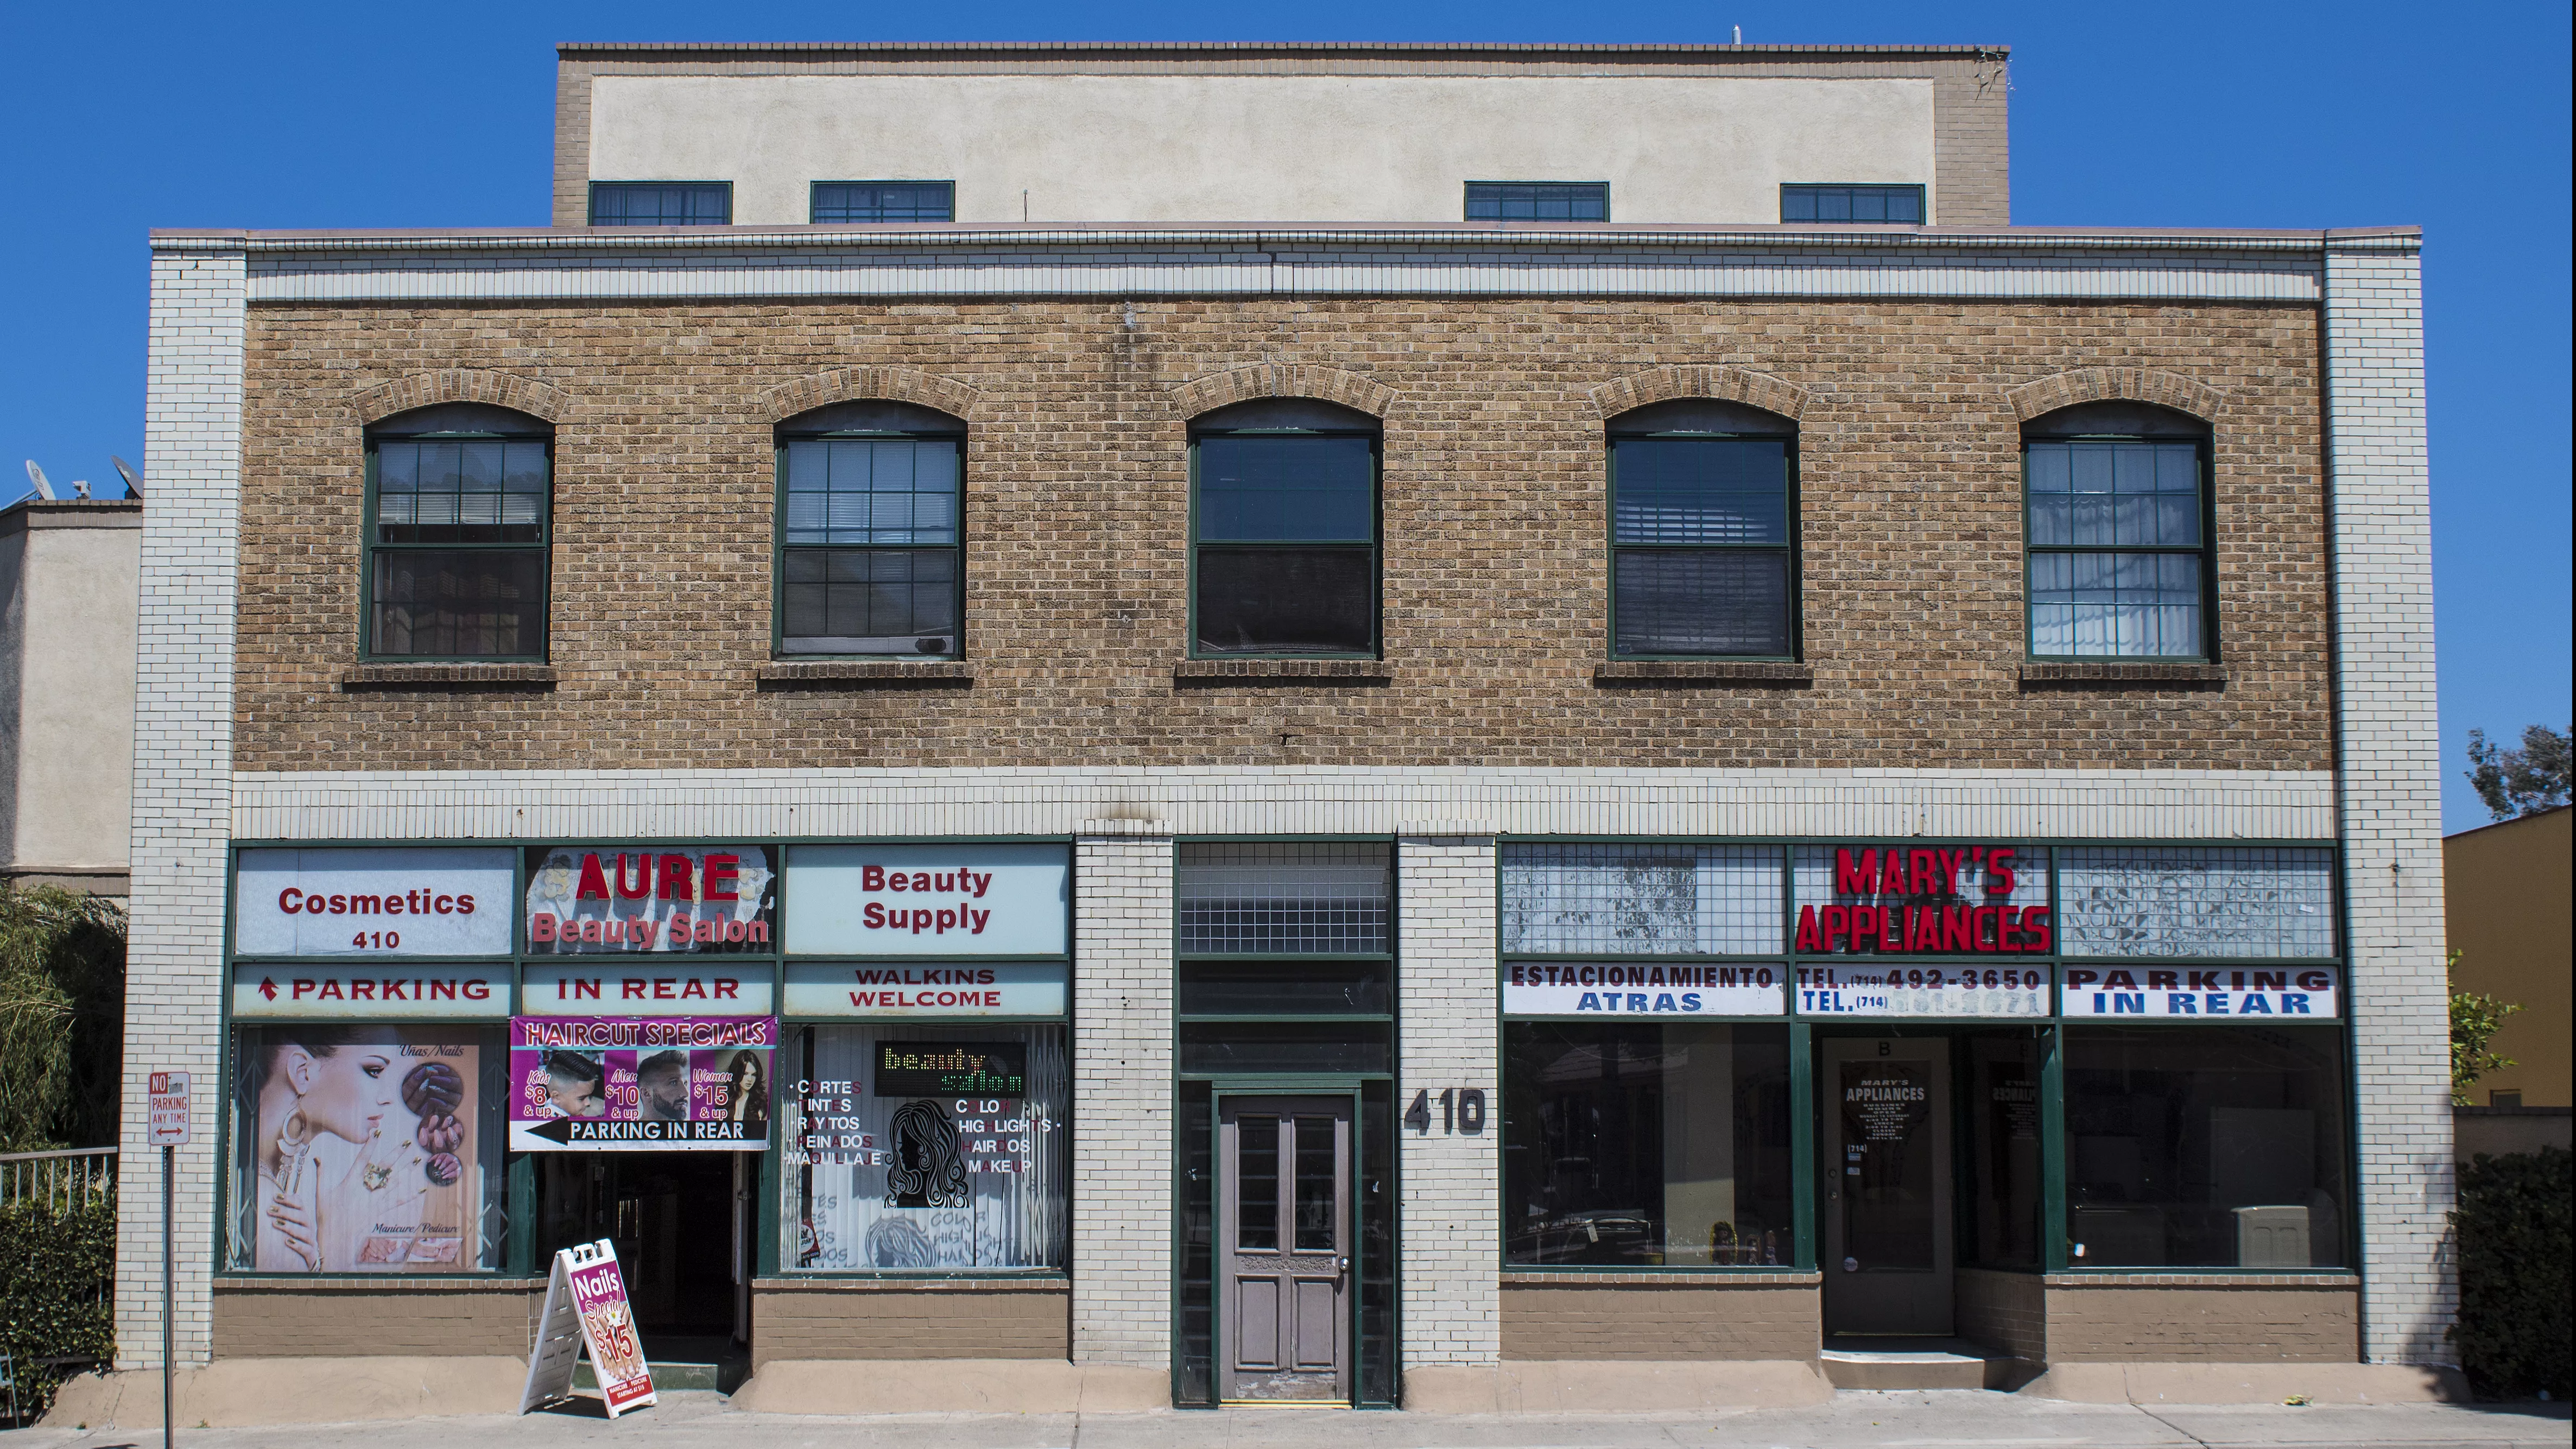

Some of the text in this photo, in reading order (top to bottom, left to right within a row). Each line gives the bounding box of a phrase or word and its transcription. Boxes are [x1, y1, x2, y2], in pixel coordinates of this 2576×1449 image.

[575, 853, 740, 901] AURE
[1837, 846, 2015, 895] MARY'S
[862, 865, 992, 898] Beauty
[279, 888, 476, 914] Cosmetics
[863, 902, 991, 934] Supply
[533, 913, 769, 949] Beauty Salon
[1796, 904, 2050, 951] APPLIANCES
[352, 932, 400, 948] 410
[855, 970, 995, 985] WALKINS
[1511, 966, 1773, 989] ESTACIONAMIENTO
[1797, 968, 2040, 990] TEL. (714) 492-3650
[2068, 970, 2330, 992] PARKING
[293, 979, 490, 1000] PARKING
[558, 978, 738, 999] IN REAR
[849, 991, 1001, 1007] WELCOME
[1576, 992, 1701, 1012] ATRAS
[1803, 991, 1853, 1012] TEL.
[1856, 996, 1888, 1009] (714)
[2093, 992, 2311, 1014] IN REAR
[526, 1022, 767, 1047] HAIRCUT SPECIALS
[1879, 1042, 1891, 1056] B
[885, 1048, 985, 1076] beauty
[152, 1075, 166, 1092] NO
[527, 1070, 552, 1085] Kids
[611, 1069, 638, 1083] Men
[693, 1069, 733, 1082] Women
[941, 1070, 1021, 1091] salon
[525, 1086, 547, 1105] $8
[606, 1086, 640, 1105] $10
[694, 1086, 729, 1105] $15
[798, 1079, 862, 1094] CORTES
[1846, 1087, 1925, 1101] APPLIANCES
[153, 1097, 187, 1111] PARKING
[524, 1106, 552, 1117] & up
[799, 1098, 852, 1112] TINTES
[955, 1099, 1010, 1113] COLOR
[1404, 1087, 1485, 1129] 410
[153, 1113, 186, 1124] ANY TIME
[612, 1108, 640, 1120] & up
[700, 1108, 728, 1120] & up
[571, 1122, 744, 1140] PARKING IN REAR
[798, 1117, 860, 1130] RAYITOS
[958, 1118, 1051, 1132] HIGHLIGHTS
[797, 1135, 872, 1148] PEINADOS
[962, 1140, 1030, 1153] HAIRDOS
[1847, 1143, 1867, 1153] (714)
[788, 1151, 881, 1165] MAQUILLAJE
[969, 1160, 1031, 1173] MAKEUP
[574, 1268, 619, 1301] Nails
[585, 1290, 622, 1324] Special
[595, 1324, 634, 1362] $15
